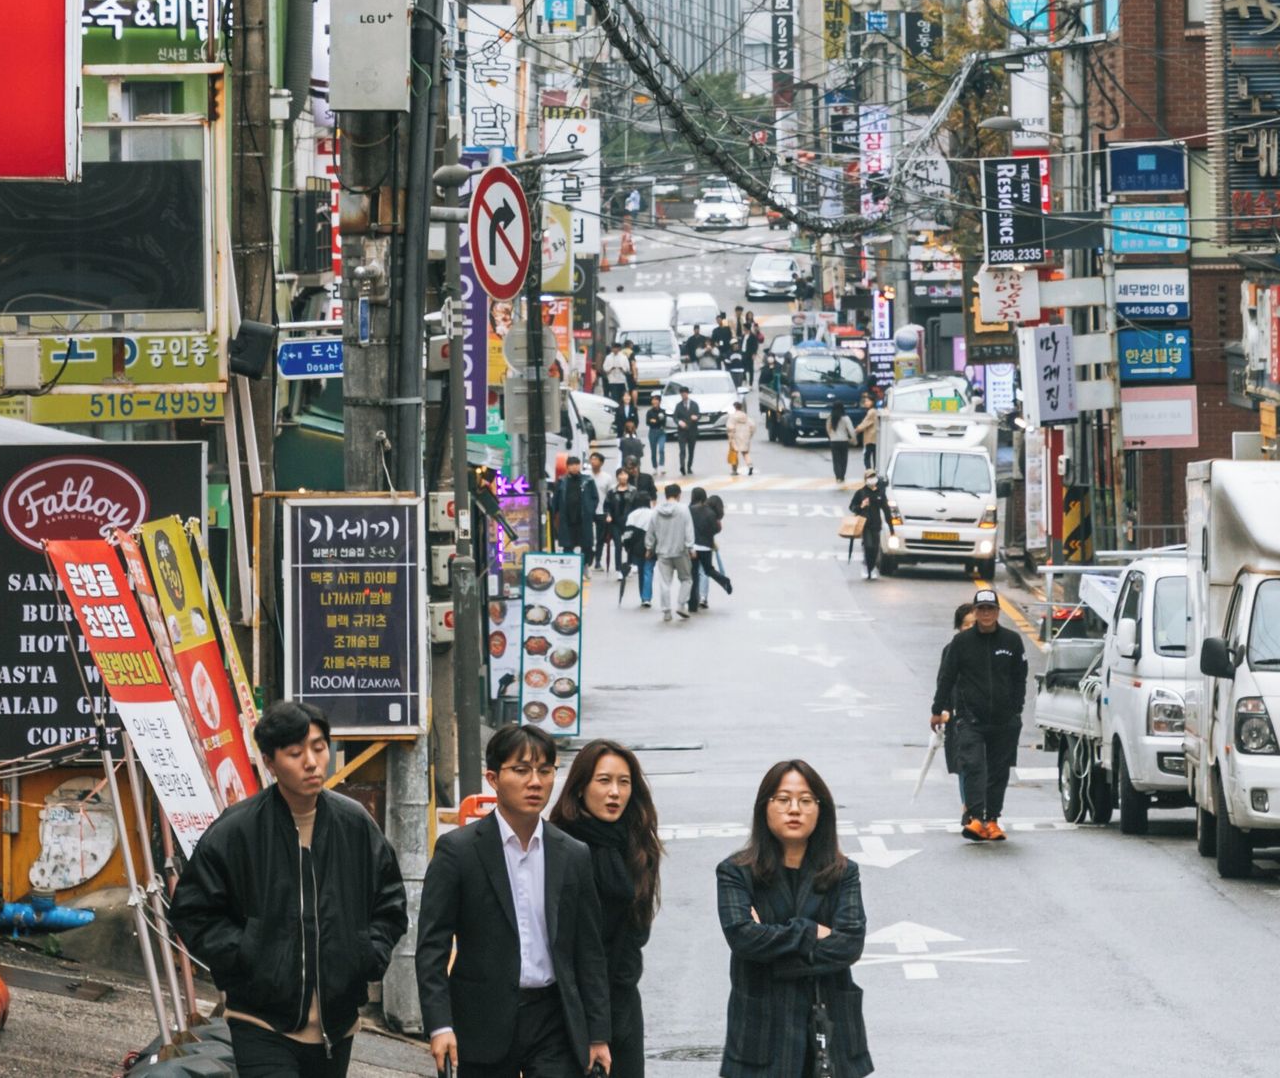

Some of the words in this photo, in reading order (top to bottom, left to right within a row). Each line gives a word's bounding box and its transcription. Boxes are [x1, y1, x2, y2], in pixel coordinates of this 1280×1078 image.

[360, 14, 375, 24] LG
[158, 47, 190, 62] 신사점
[990, 248, 1041, 262] 2088.2335
[1118, 284, 1160, 296] 세무법인
[1124, 306, 1165, 315] 540-6563
[1125, 347, 1182, 365] 한성빌딩
[90, 392, 217, 418] 516-4959
[18, 476, 133, 547] Fatboy
[308, 514, 400, 543] 기세끼
[64, 562, 119, 598] 은행골
[337, 572, 360, 585] 사케
[320, 591, 366, 606] 나가사끼
[80, 604, 136, 639] 초밥집
[20, 635, 70, 654] HOT
[310, 675, 355, 689] ROOM
[357, 677, 401, 689] IZAKAYA
[27, 727, 118, 745] COFFEE
